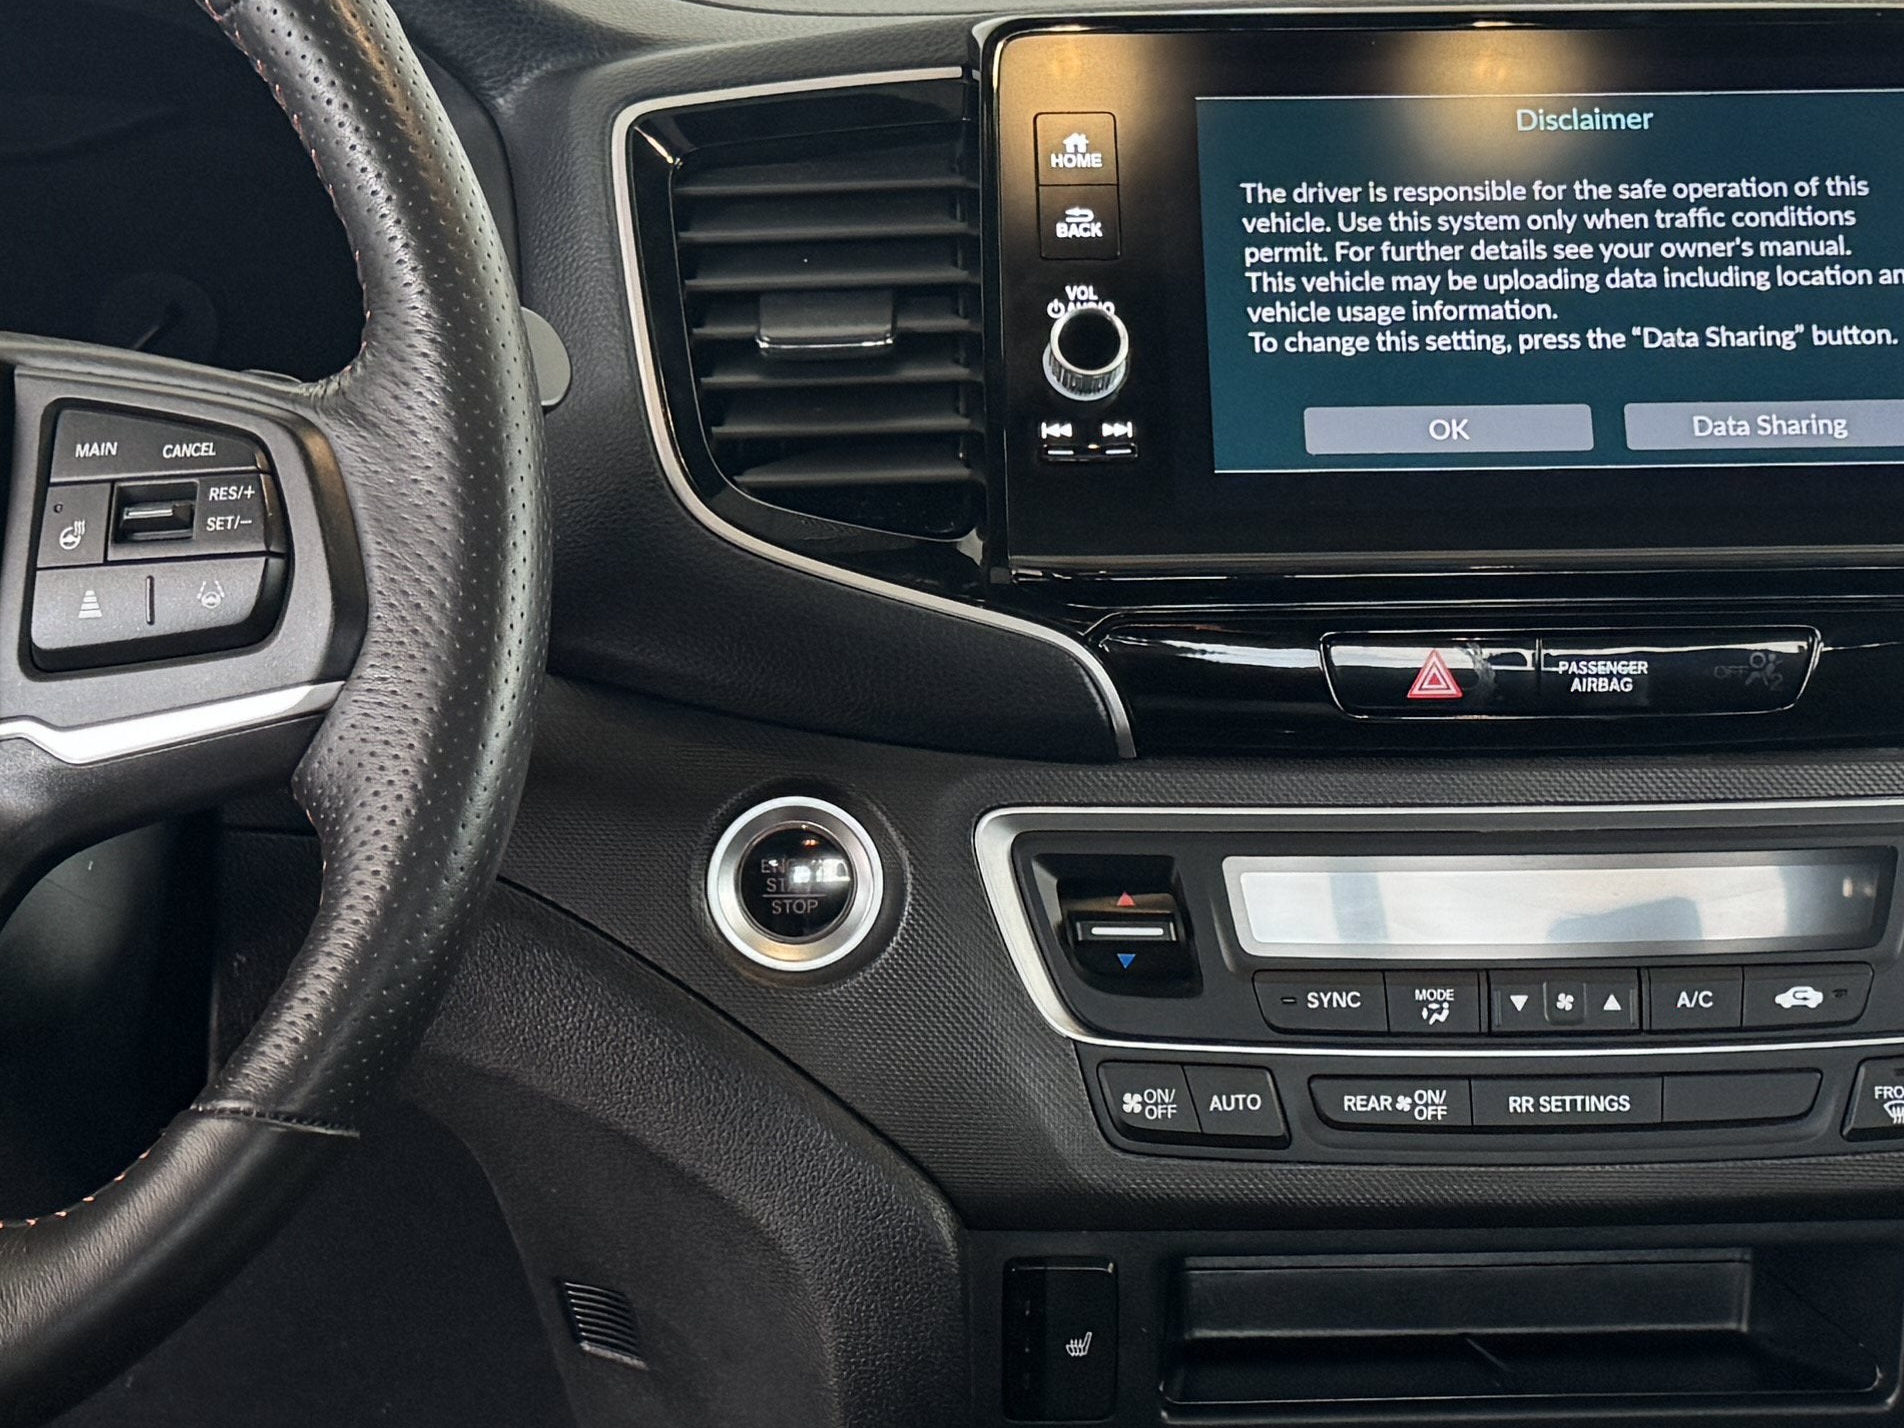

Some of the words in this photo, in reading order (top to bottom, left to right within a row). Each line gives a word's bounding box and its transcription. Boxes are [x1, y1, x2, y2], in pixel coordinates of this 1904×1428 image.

[1516, 105, 1655, 132] Disclaimer
[1050, 153, 1103, 169] HOME
[1238, 181, 1288, 204] The
[1291, 180, 1363, 204] driver
[1367, 180, 1389, 203] is
[1393, 178, 1528, 207] responsible
[1531, 179, 1568, 202] for
[1572, 177, 1613, 201] the
[1617, 177, 1667, 200] safe
[1671, 175, 1789, 204] operation
[1793, 175, 1821, 198] of
[1824, 174, 1870, 197] this
[1056, 222, 1103, 238] BACK
[1241, 209, 1332, 234] vehicle.
[1337, 210, 1384, 233] Use
[1387, 206, 1433, 233] this
[1436, 210, 1522, 237] system
[1526, 207, 1578, 235] only
[1582, 207, 1650, 230] when
[1653, 205, 1727, 229] traffic
[1731, 204, 1857, 229] conditions
[1243, 239, 1329, 268] permit.
[1334, 240, 1376, 263] For
[1379, 238, 1465, 263] further
[1469, 237, 1549, 262] details
[1552, 242, 1595, 261] see
[1597, 241, 1655, 264] your
[1659, 235, 1755, 259] owner's
[1759, 233, 1853, 258] manual.
[1243, 269, 1297, 294] This
[1300, 268, 1386, 293] vehicle
[1390, 273, 1442, 296] may
[1447, 267, 1478, 292] be
[1482, 265, 1601, 295] uploading
[1604, 265, 1658, 290] data
[1662, 264, 1772, 292] including
[1775, 263, 1874, 287] location
[1065, 285, 1099, 302] VOL
[1246, 299, 1332, 324] vehicle
[1336, 304, 1407, 327] usage
[1411, 297, 1559, 322] information.
[1247, 330, 1279, 354] To
[1283, 329, 1371, 357] change
[1374, 326, 1421, 353] this
[1424, 328, 1513, 356] setting,
[1518, 331, 1582, 355] press
[1585, 326, 1627, 350] the
[1810, 323, 1899, 347] button.
[1427, 418, 1471, 443] OK
[1692, 413, 1751, 439] Data
[1756, 413, 1849, 442] Sharing
[75, 441, 118, 458] MAIN
[162, 441, 217, 460] CANCEL
[1558, 659, 1649, 677] PASSENGER
[1570, 676, 1634, 693] AIRBAG
[771, 898, 819, 915] STOP
[1306, 990, 1362, 1010] SYNC
[1413, 988, 1455, 1002] MODE
[1676, 990, 1713, 1009] A/C
[1143, 1088, 1176, 1104] ON/
[1208, 1093, 1262, 1112] AUTO
[1343, 1094, 1393, 1112] REAR
[1413, 1089, 1447, 1105] ON/
[1508, 1095, 1535, 1113] RR
[1538, 1095, 1631, 1113] SETTINGS
[1143, 1103, 1178, 1120] OFF
[1413, 1103, 1448, 1121] OFF
